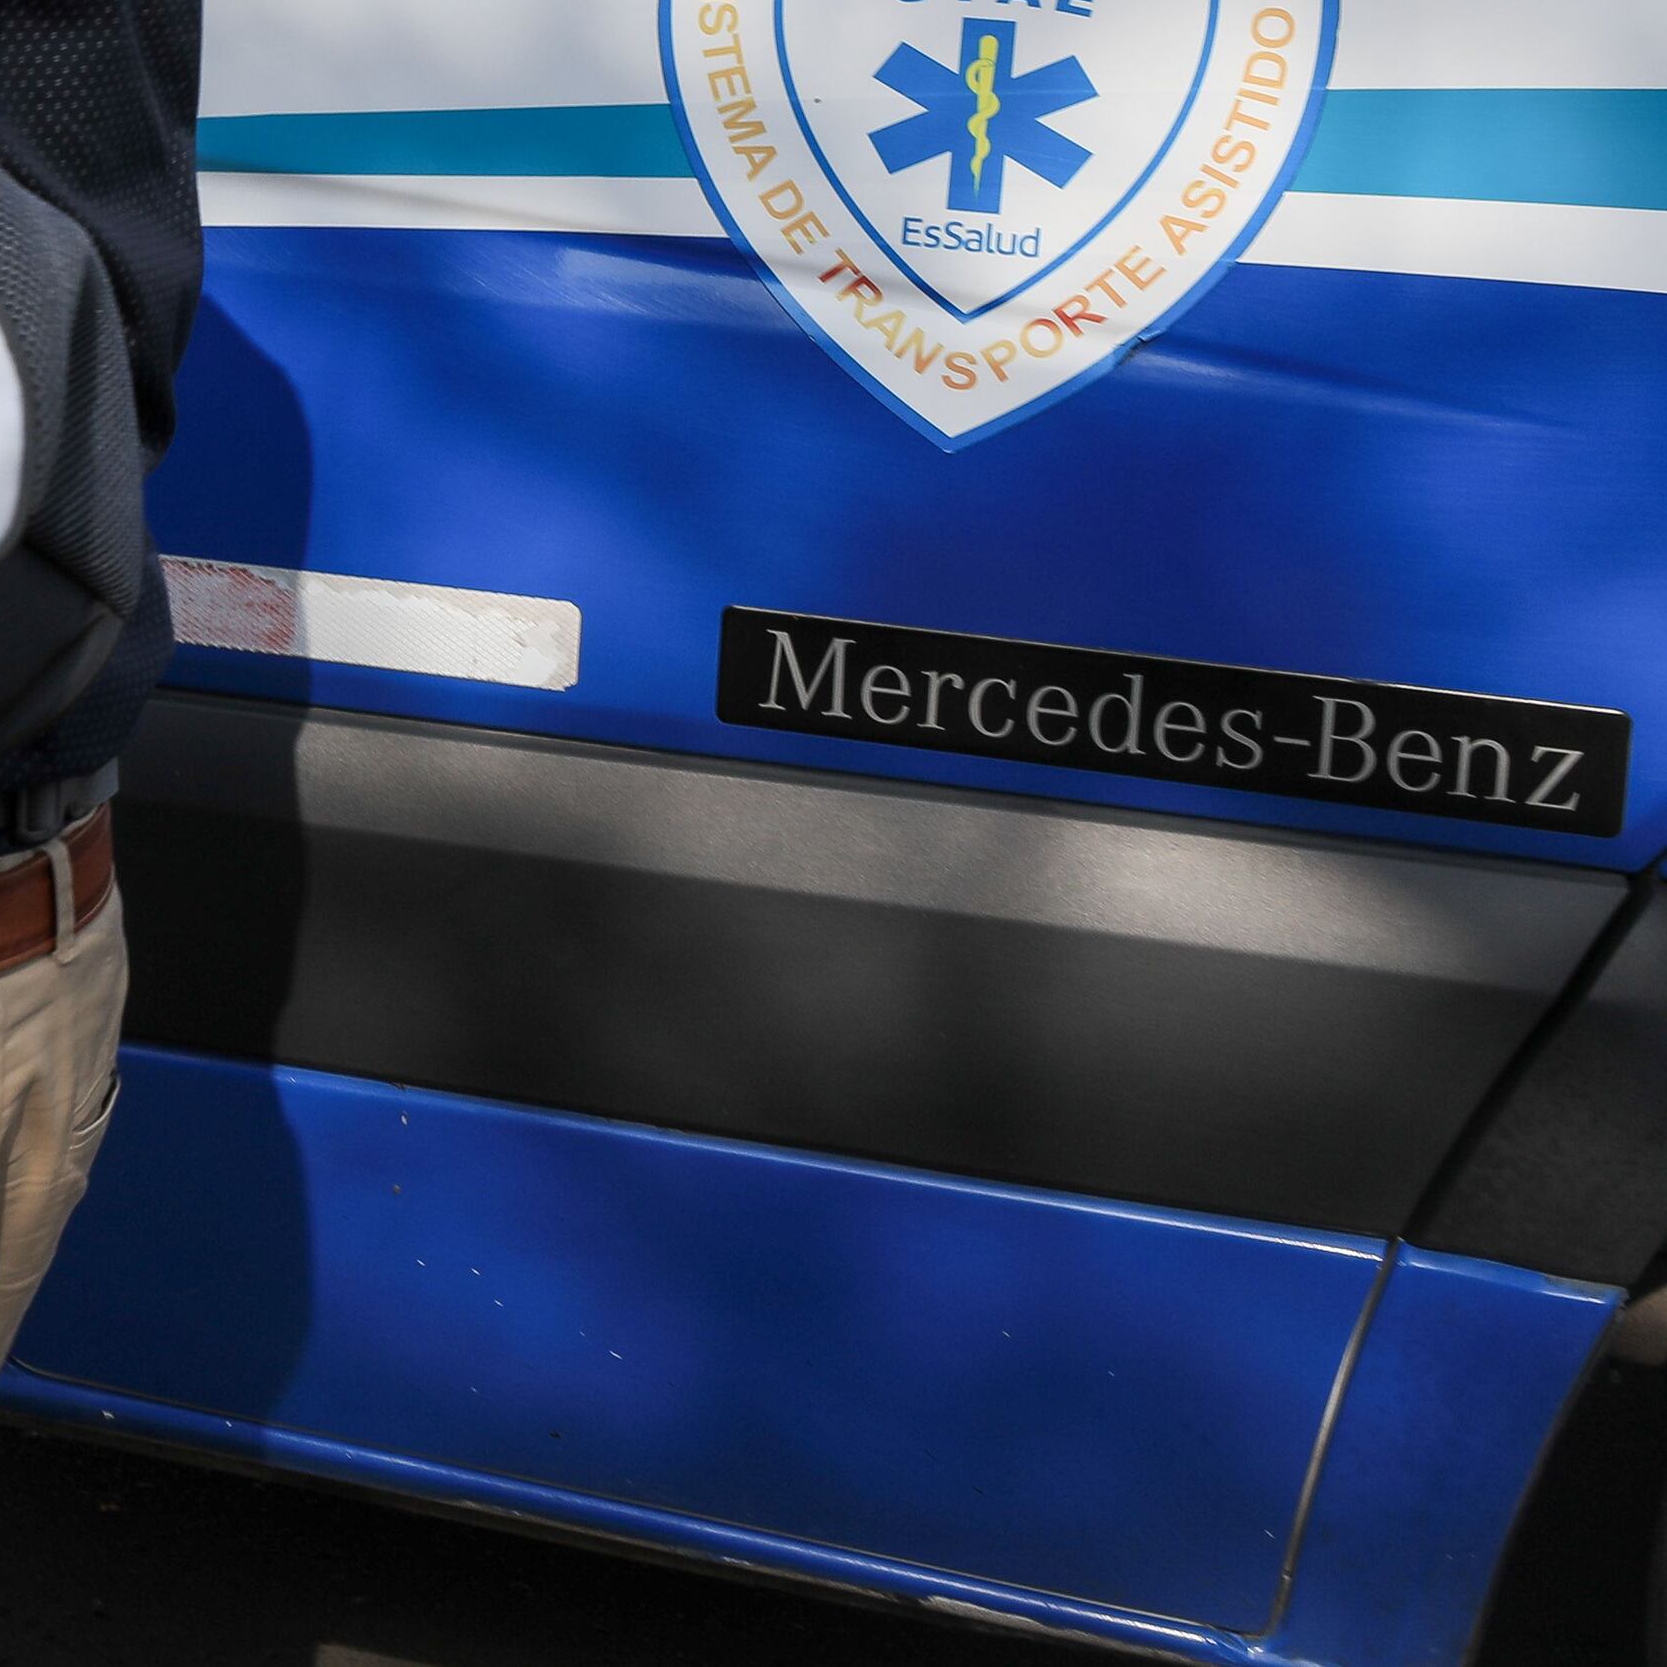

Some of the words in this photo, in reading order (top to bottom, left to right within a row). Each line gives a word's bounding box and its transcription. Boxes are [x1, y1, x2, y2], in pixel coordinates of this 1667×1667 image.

[758, 181, 830, 255] DE
[817, 245, 1167, 391] TRANSPORTE
[1159, 7, 1296, 255] ASISTIDO
[901, 216, 1042, 259] EsSalud
[758, 629, 1584, 812] Mercedes-Benz
